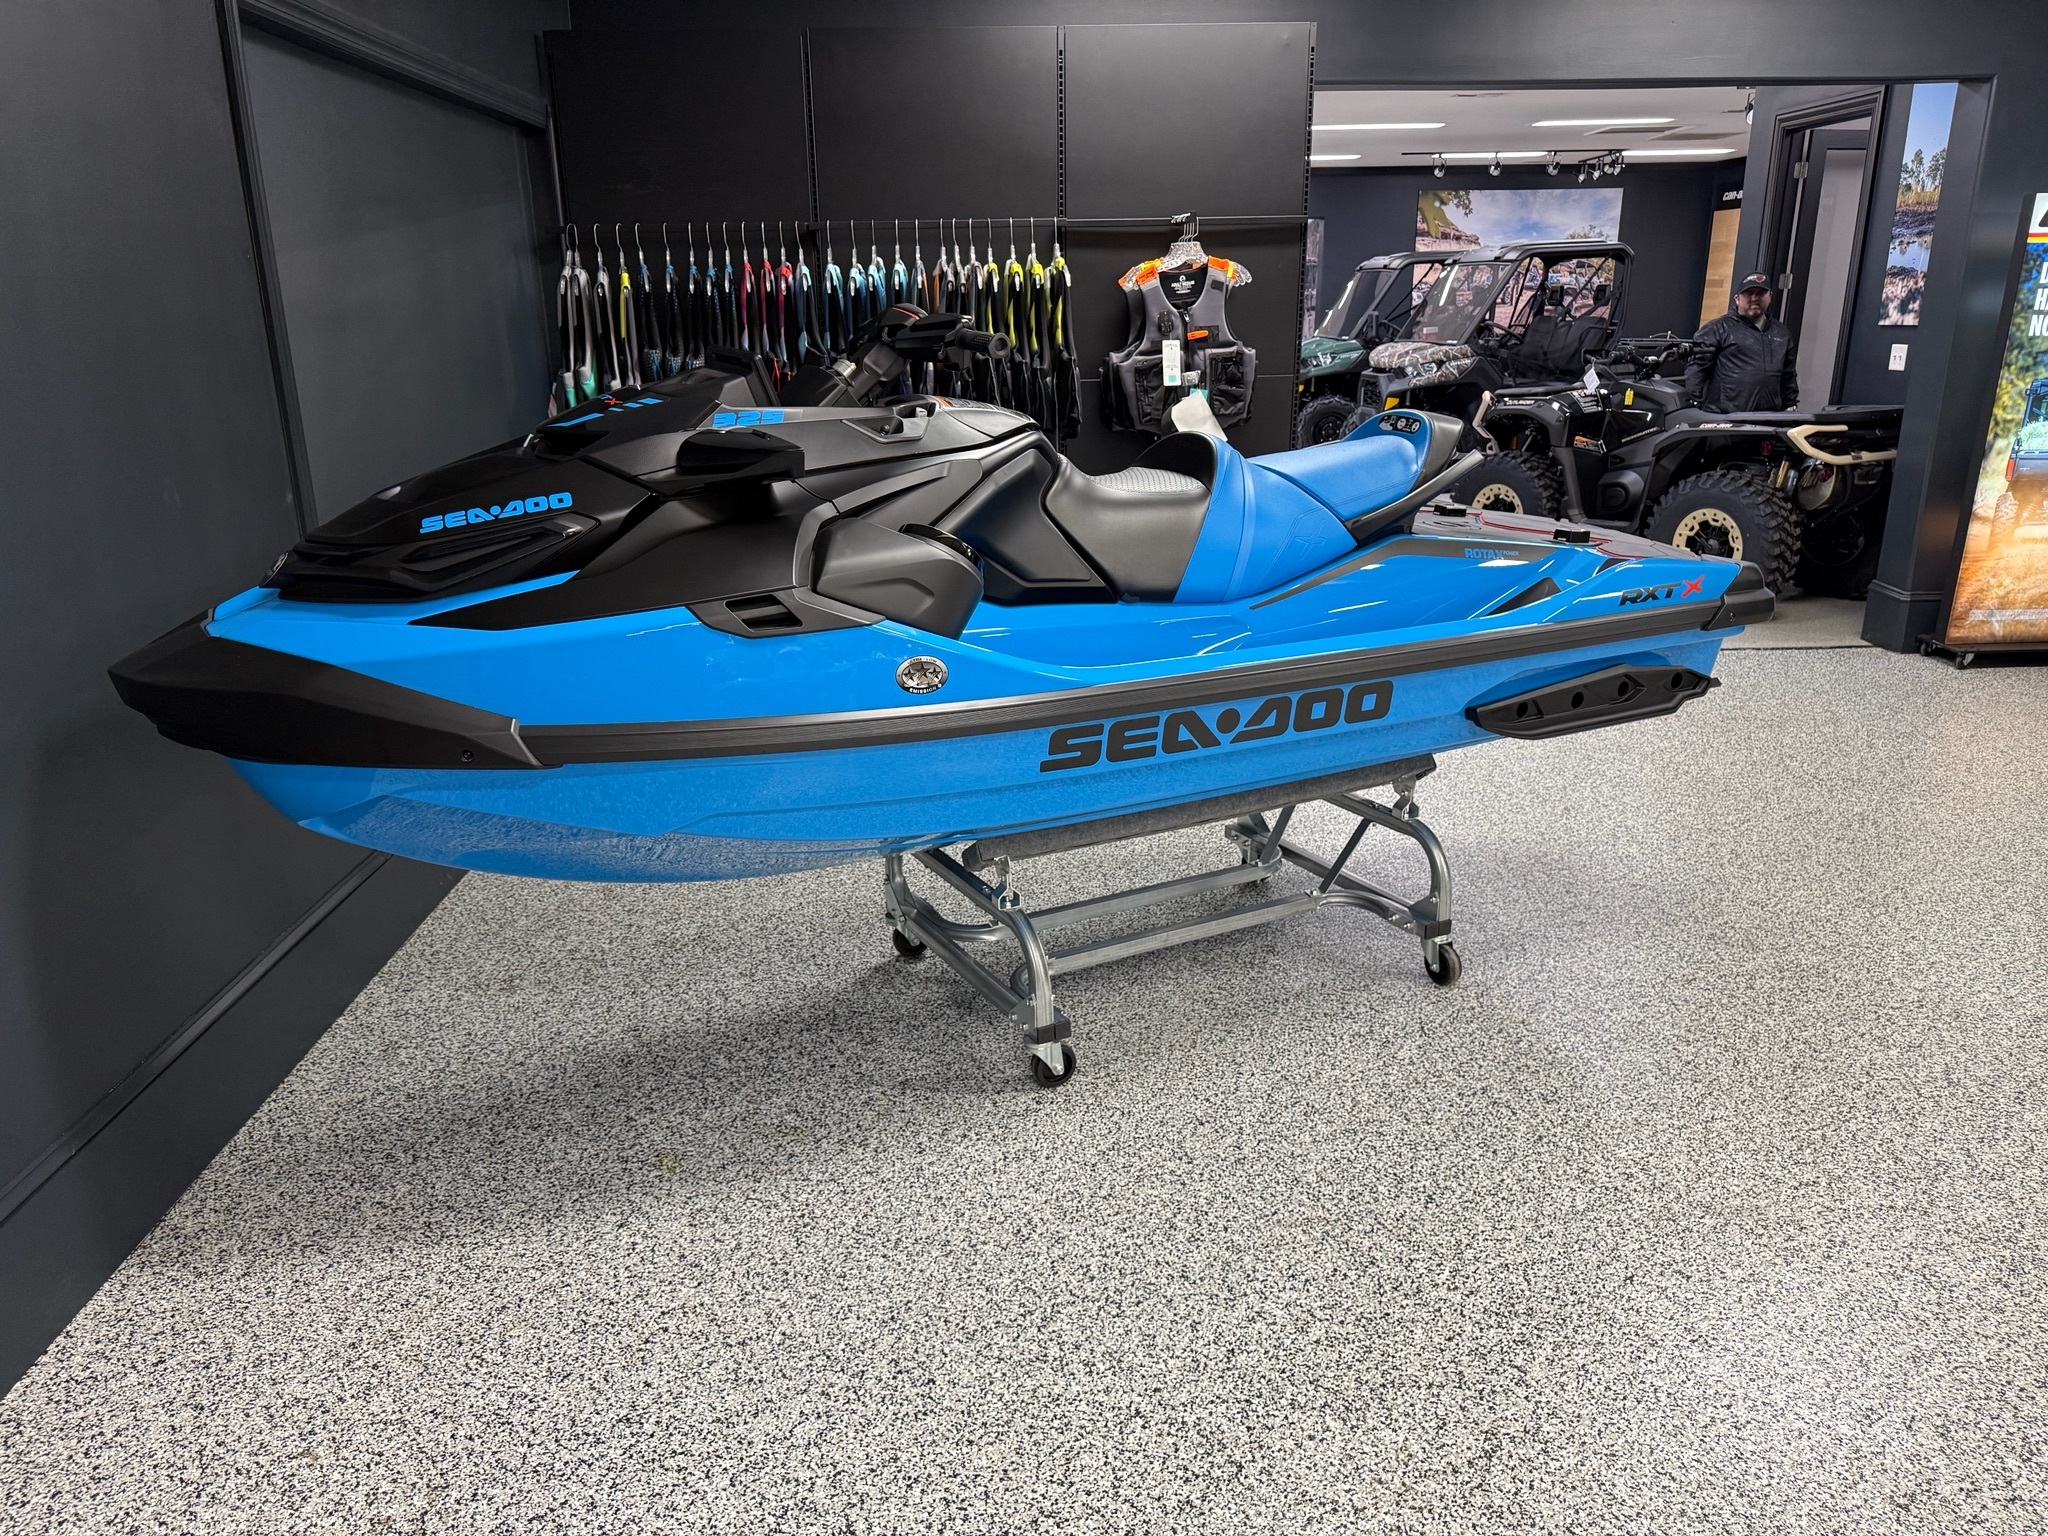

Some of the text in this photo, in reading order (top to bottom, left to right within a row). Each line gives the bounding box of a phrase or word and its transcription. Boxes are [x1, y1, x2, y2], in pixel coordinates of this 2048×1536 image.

[712, 409, 785, 428] 325
[1464, 548, 1503, 560] ROTAX
[1618, 582, 1682, 607] RXT
[909, 686, 937, 694] EMISSION
